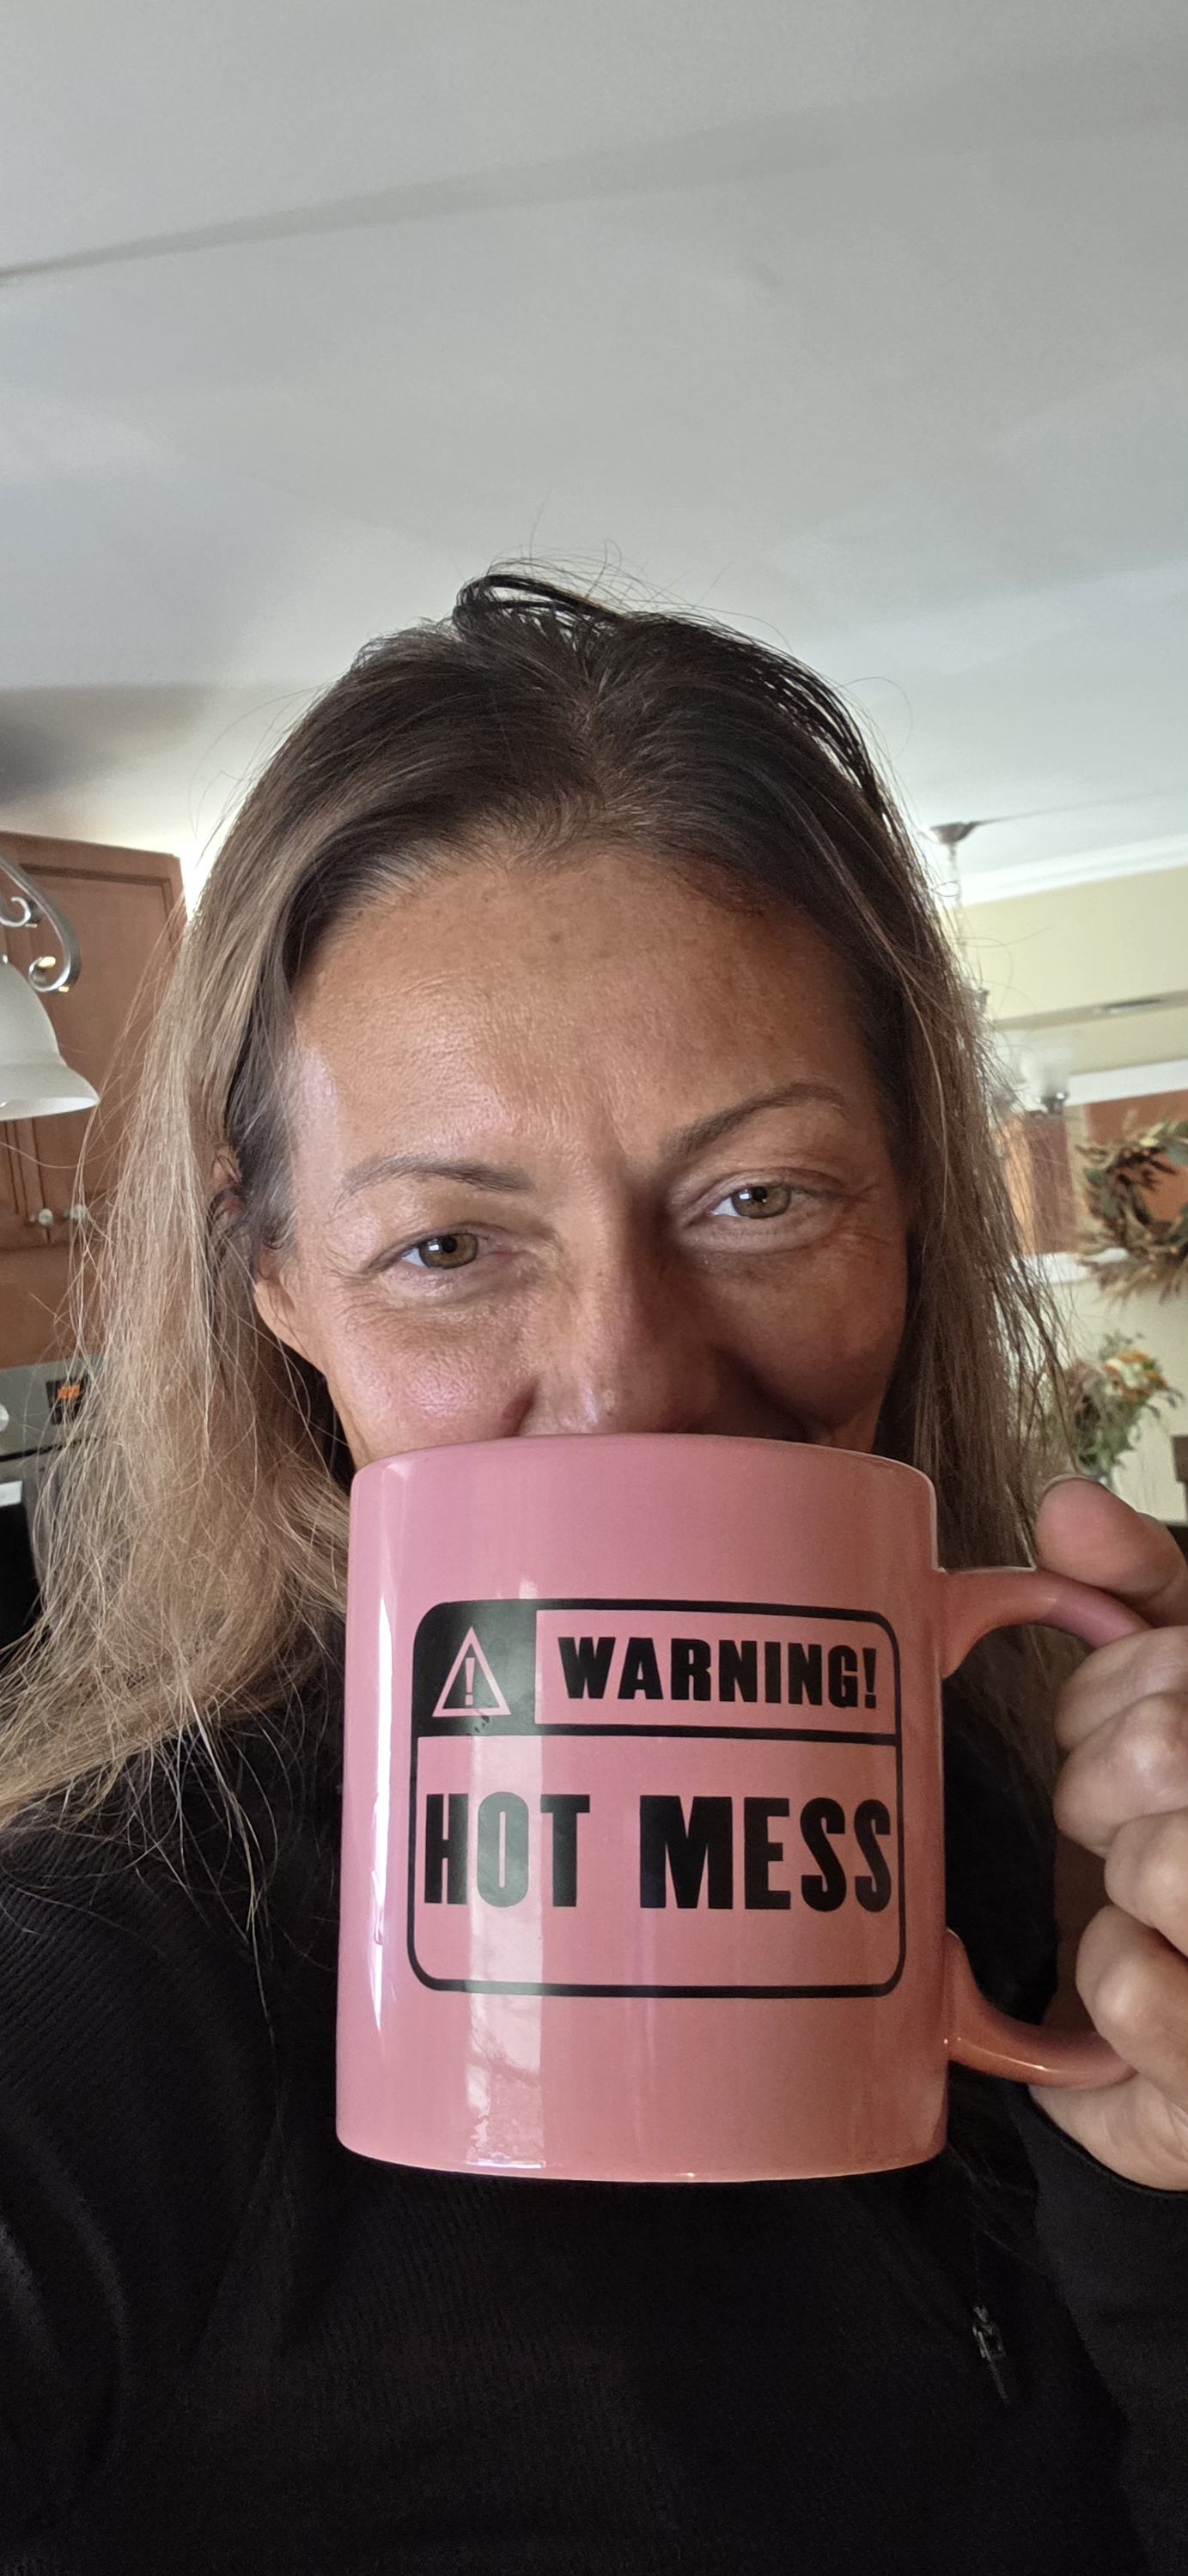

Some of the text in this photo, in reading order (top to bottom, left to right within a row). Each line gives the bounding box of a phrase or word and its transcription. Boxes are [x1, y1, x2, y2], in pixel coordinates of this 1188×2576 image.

[557, 1637, 877, 1709] WARNING!
[424, 1791, 893, 1912] HOT MESS
